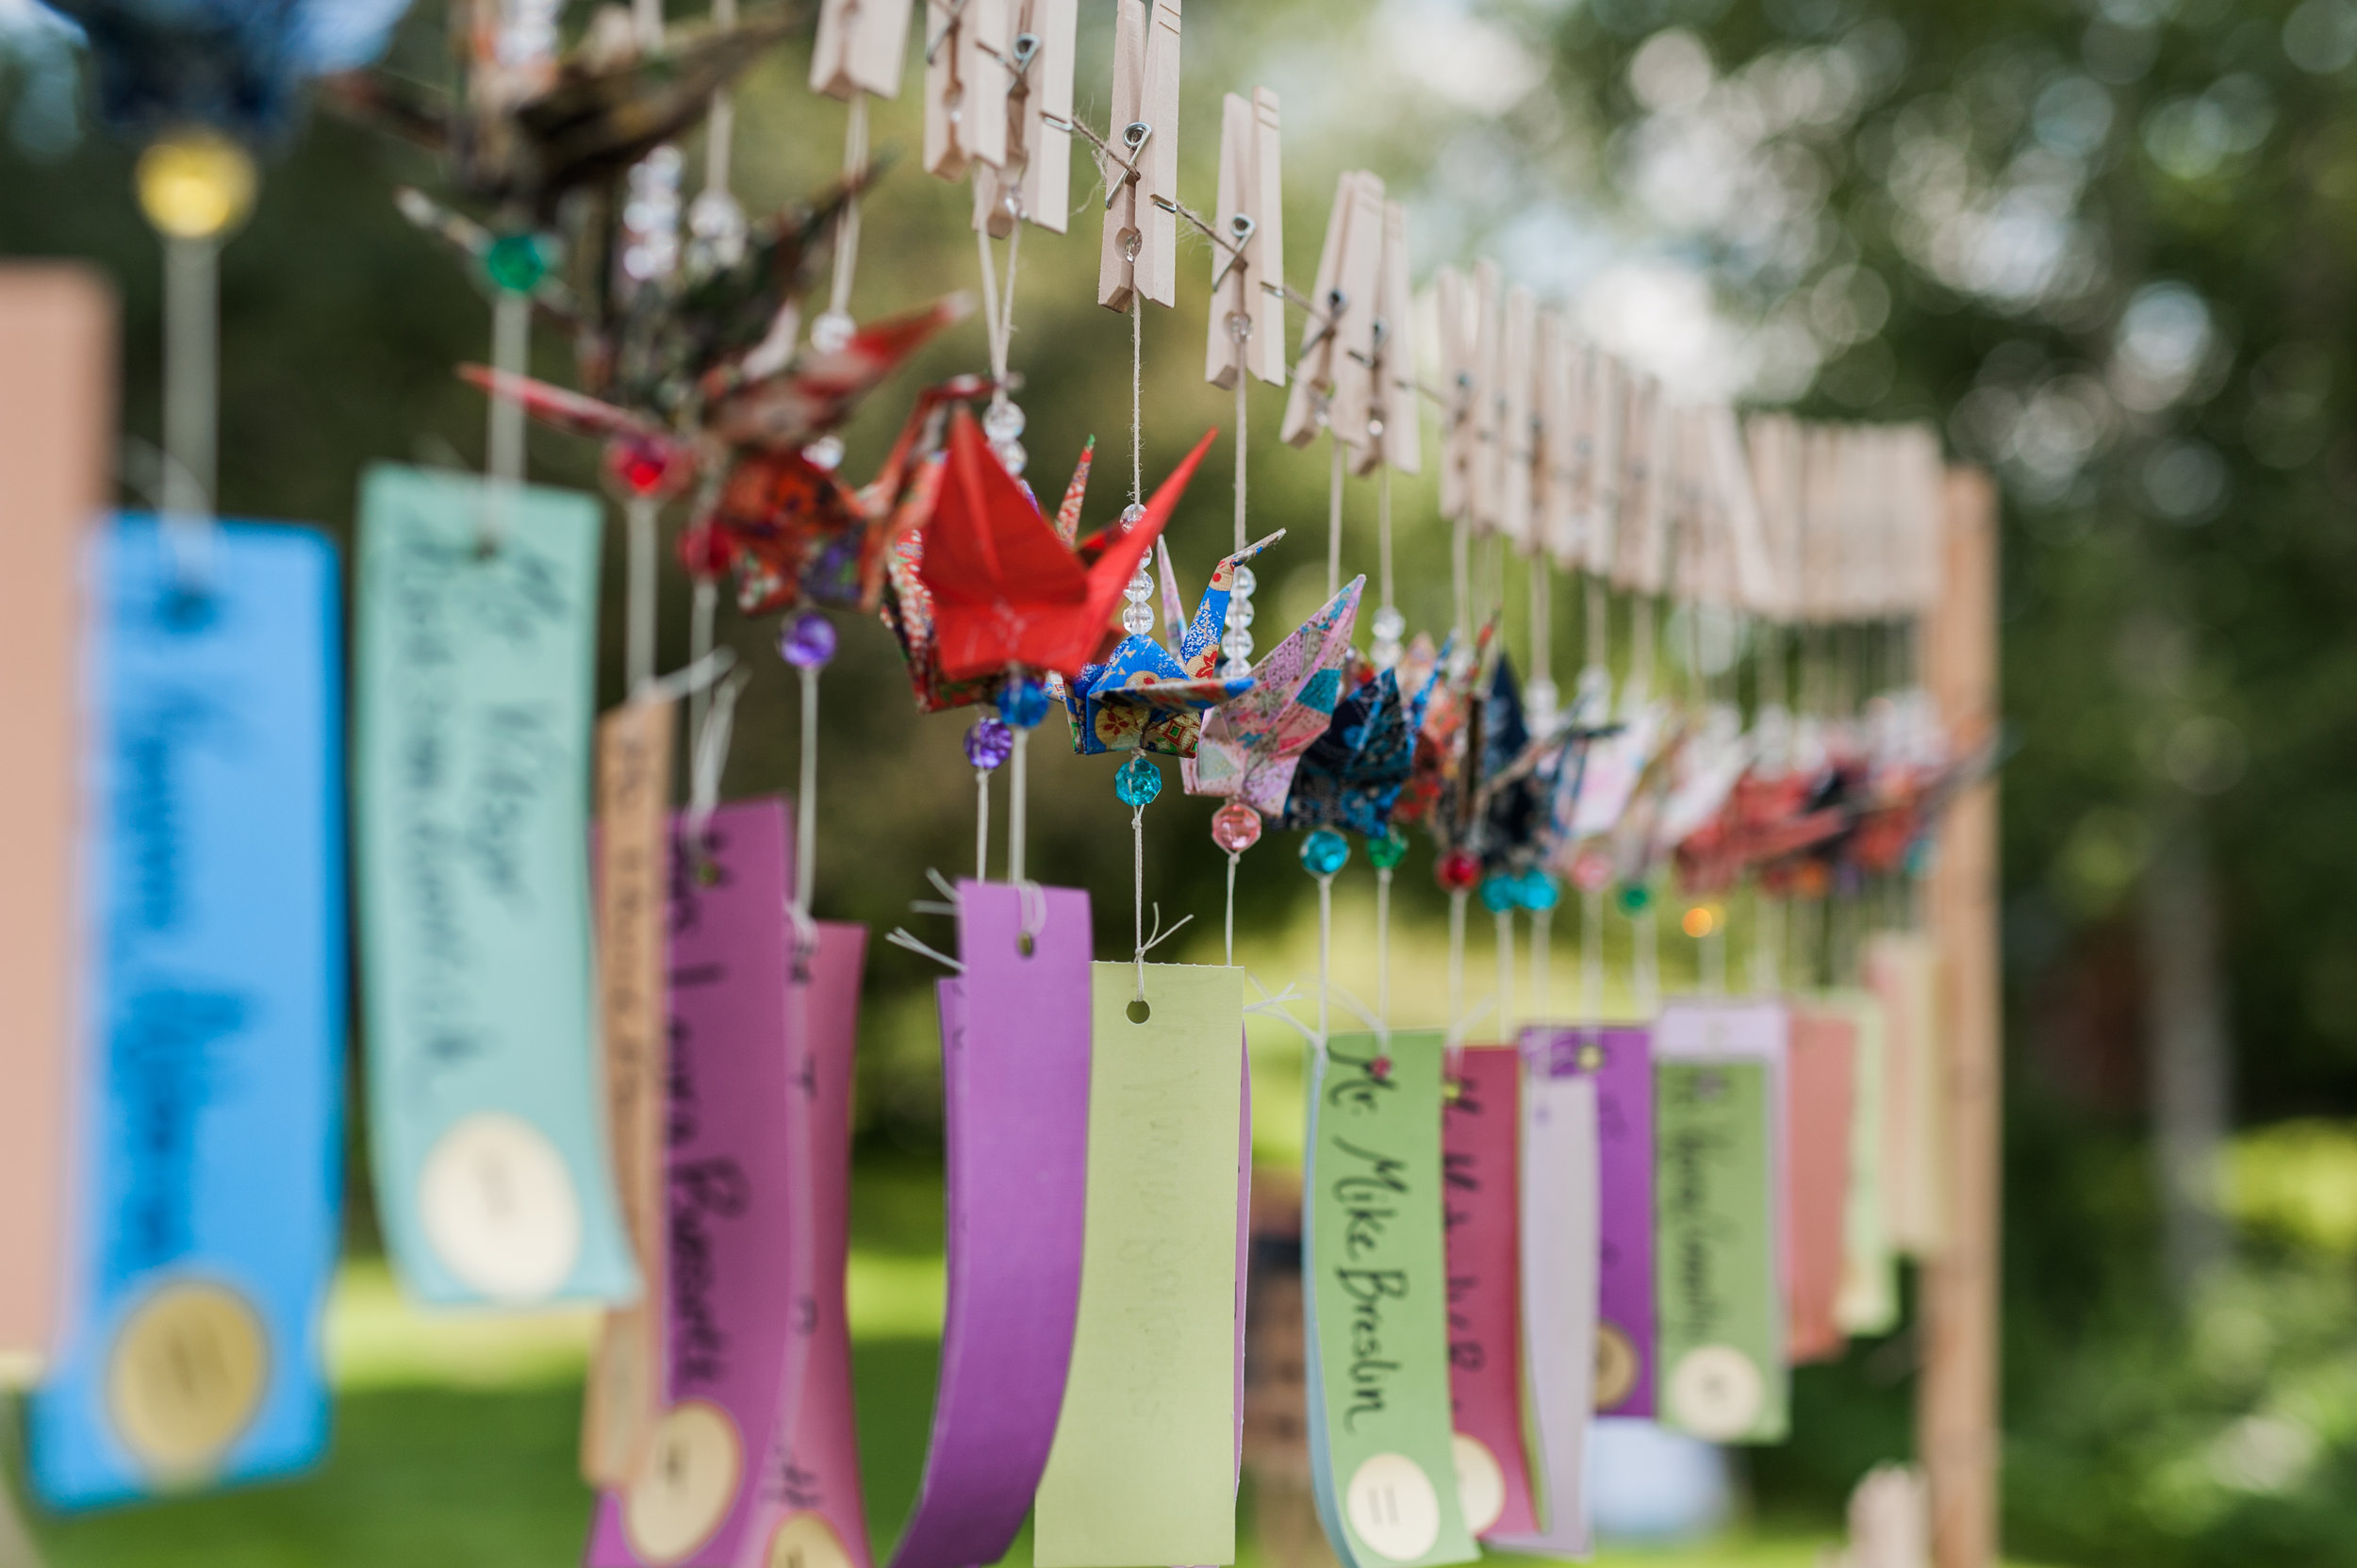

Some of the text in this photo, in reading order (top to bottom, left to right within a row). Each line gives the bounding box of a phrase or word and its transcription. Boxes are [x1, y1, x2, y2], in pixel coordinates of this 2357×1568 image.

[1327, 1045, 1409, 1435] Mr. Mike Breslin
